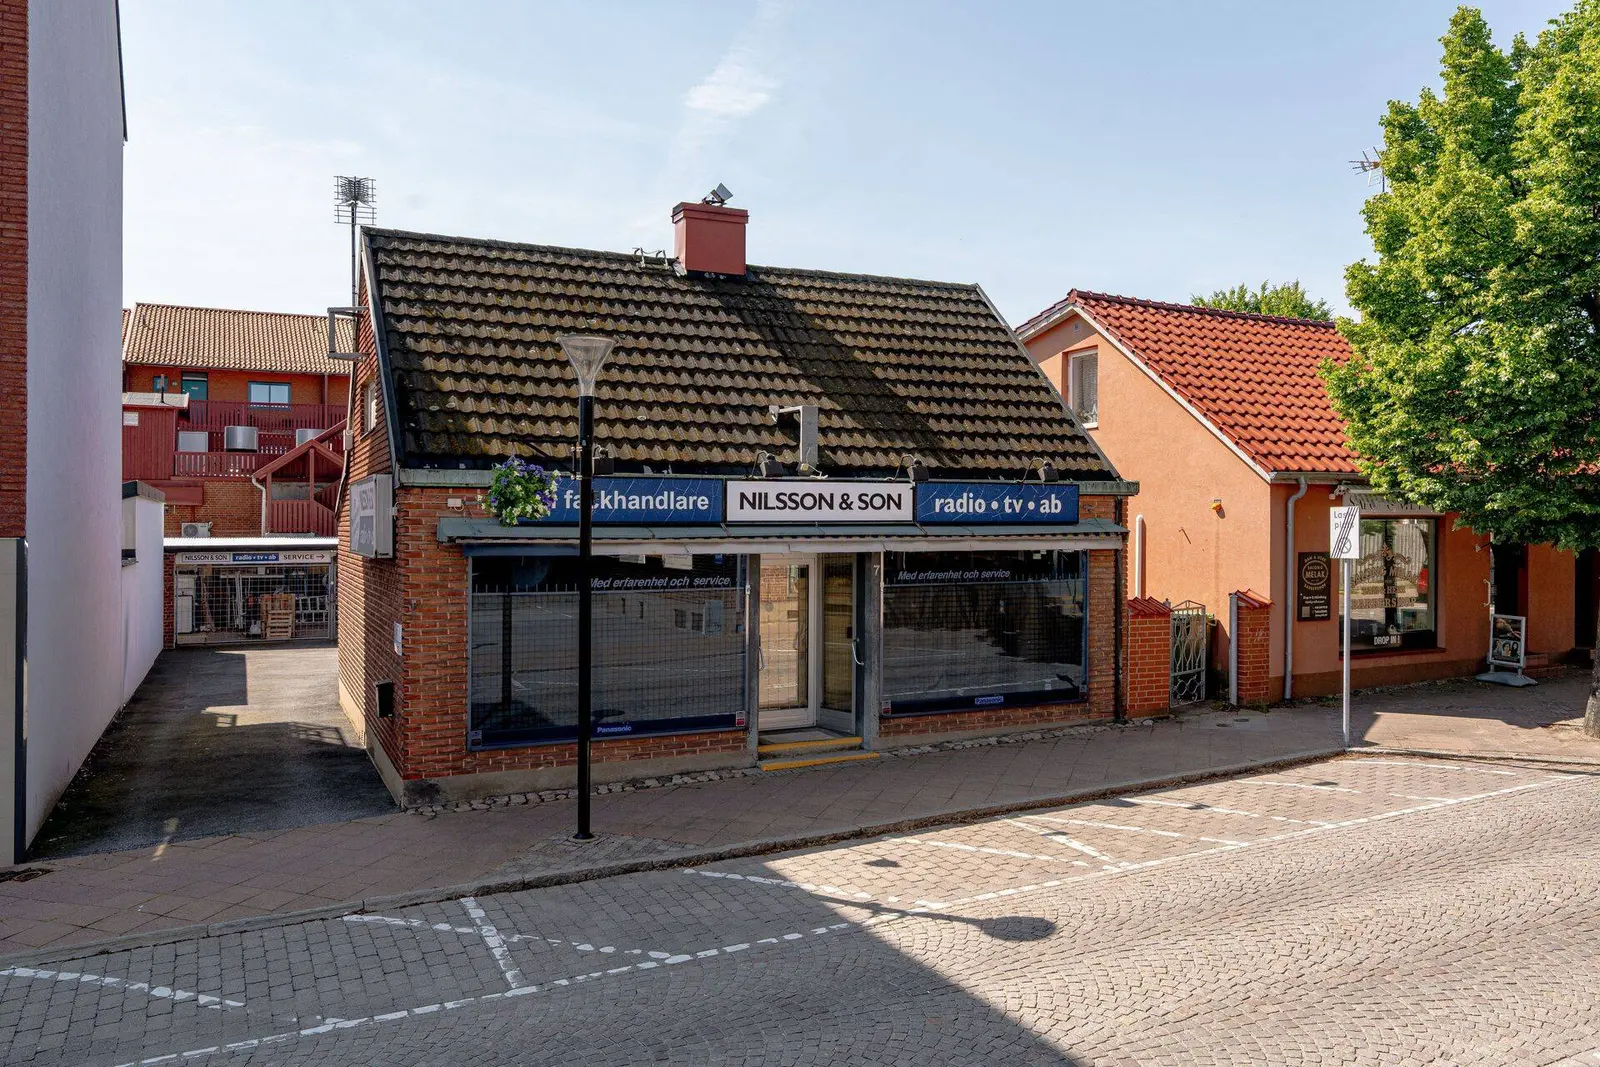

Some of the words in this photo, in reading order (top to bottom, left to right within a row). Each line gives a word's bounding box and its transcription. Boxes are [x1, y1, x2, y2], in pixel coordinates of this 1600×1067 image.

[564, 489, 709, 510] fakhandlare
[739, 492, 834, 511] NILSSON
[839, 493, 854, 511] &
[857, 493, 902, 511] SON
[934, 492, 986, 514] radio
[1003, 495, 1024, 514] tv
[1039, 493, 1062, 514] ab
[283, 553, 315, 561] SERVICE
[873, 565, 880, 576] 7
[897, 571, 918, 581] Med
[918, 570, 962, 580] erfarenhet
[963, 570, 979, 579] och
[981, 569, 1010, 579] service
[613, 577, 668, 588] erfarenhet
[669, 576, 690, 587] och
[693, 575, 731, 586] service
[1373, 636, 1390, 646] DROP
[596, 725, 633, 733] Panasonic
